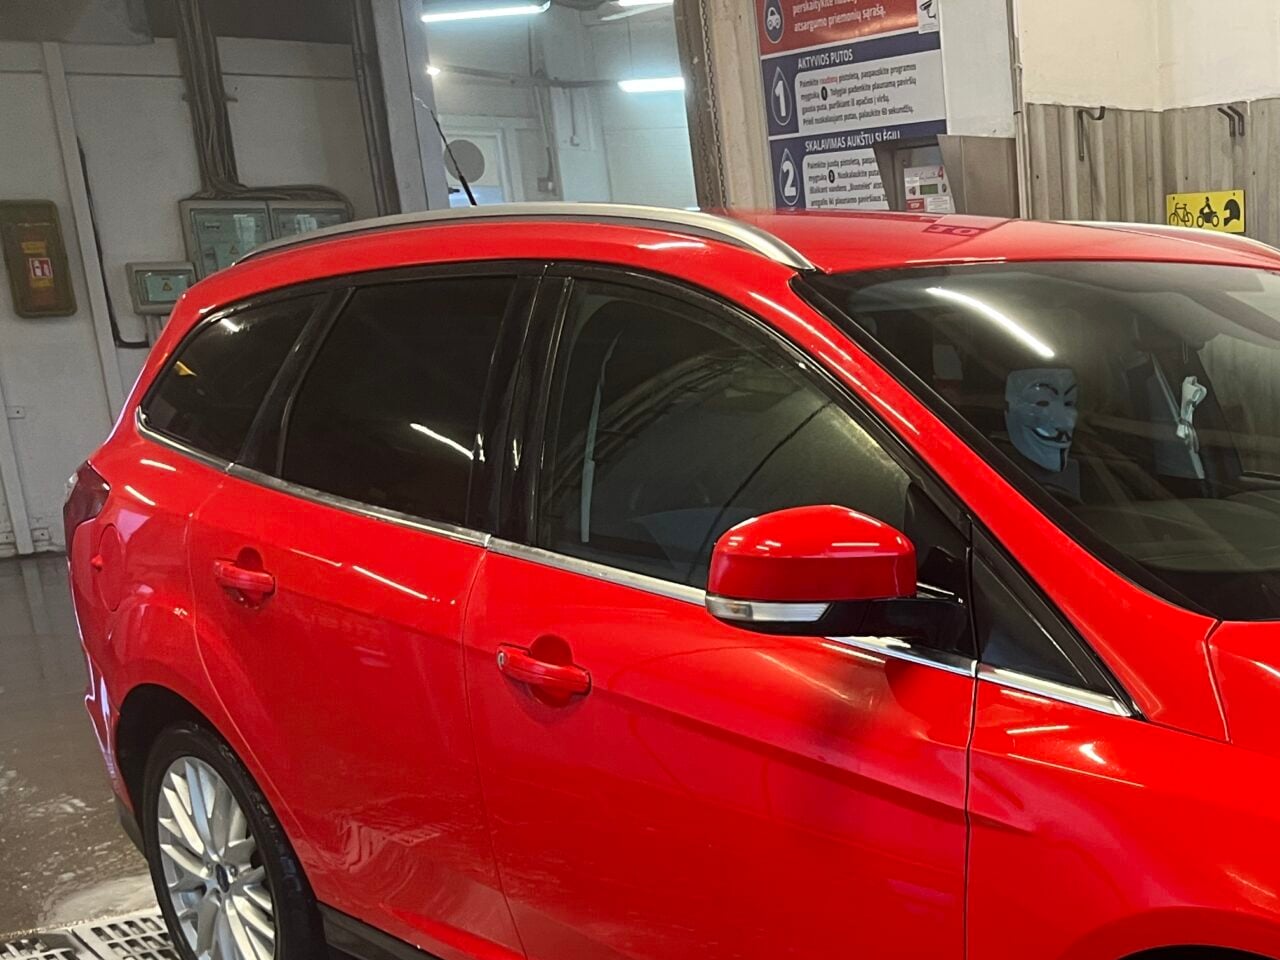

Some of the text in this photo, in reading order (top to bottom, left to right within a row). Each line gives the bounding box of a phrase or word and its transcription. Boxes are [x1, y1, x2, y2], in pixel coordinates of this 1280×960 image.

[798, 48, 853, 70] AKTYVIOS PUTOS
[775, 80, 786, 117] 1
[805, 136, 846, 152] SKALAVIMAS
[847, 131, 875, 149] AUKŠTU
[782, 160, 796, 196] 2
